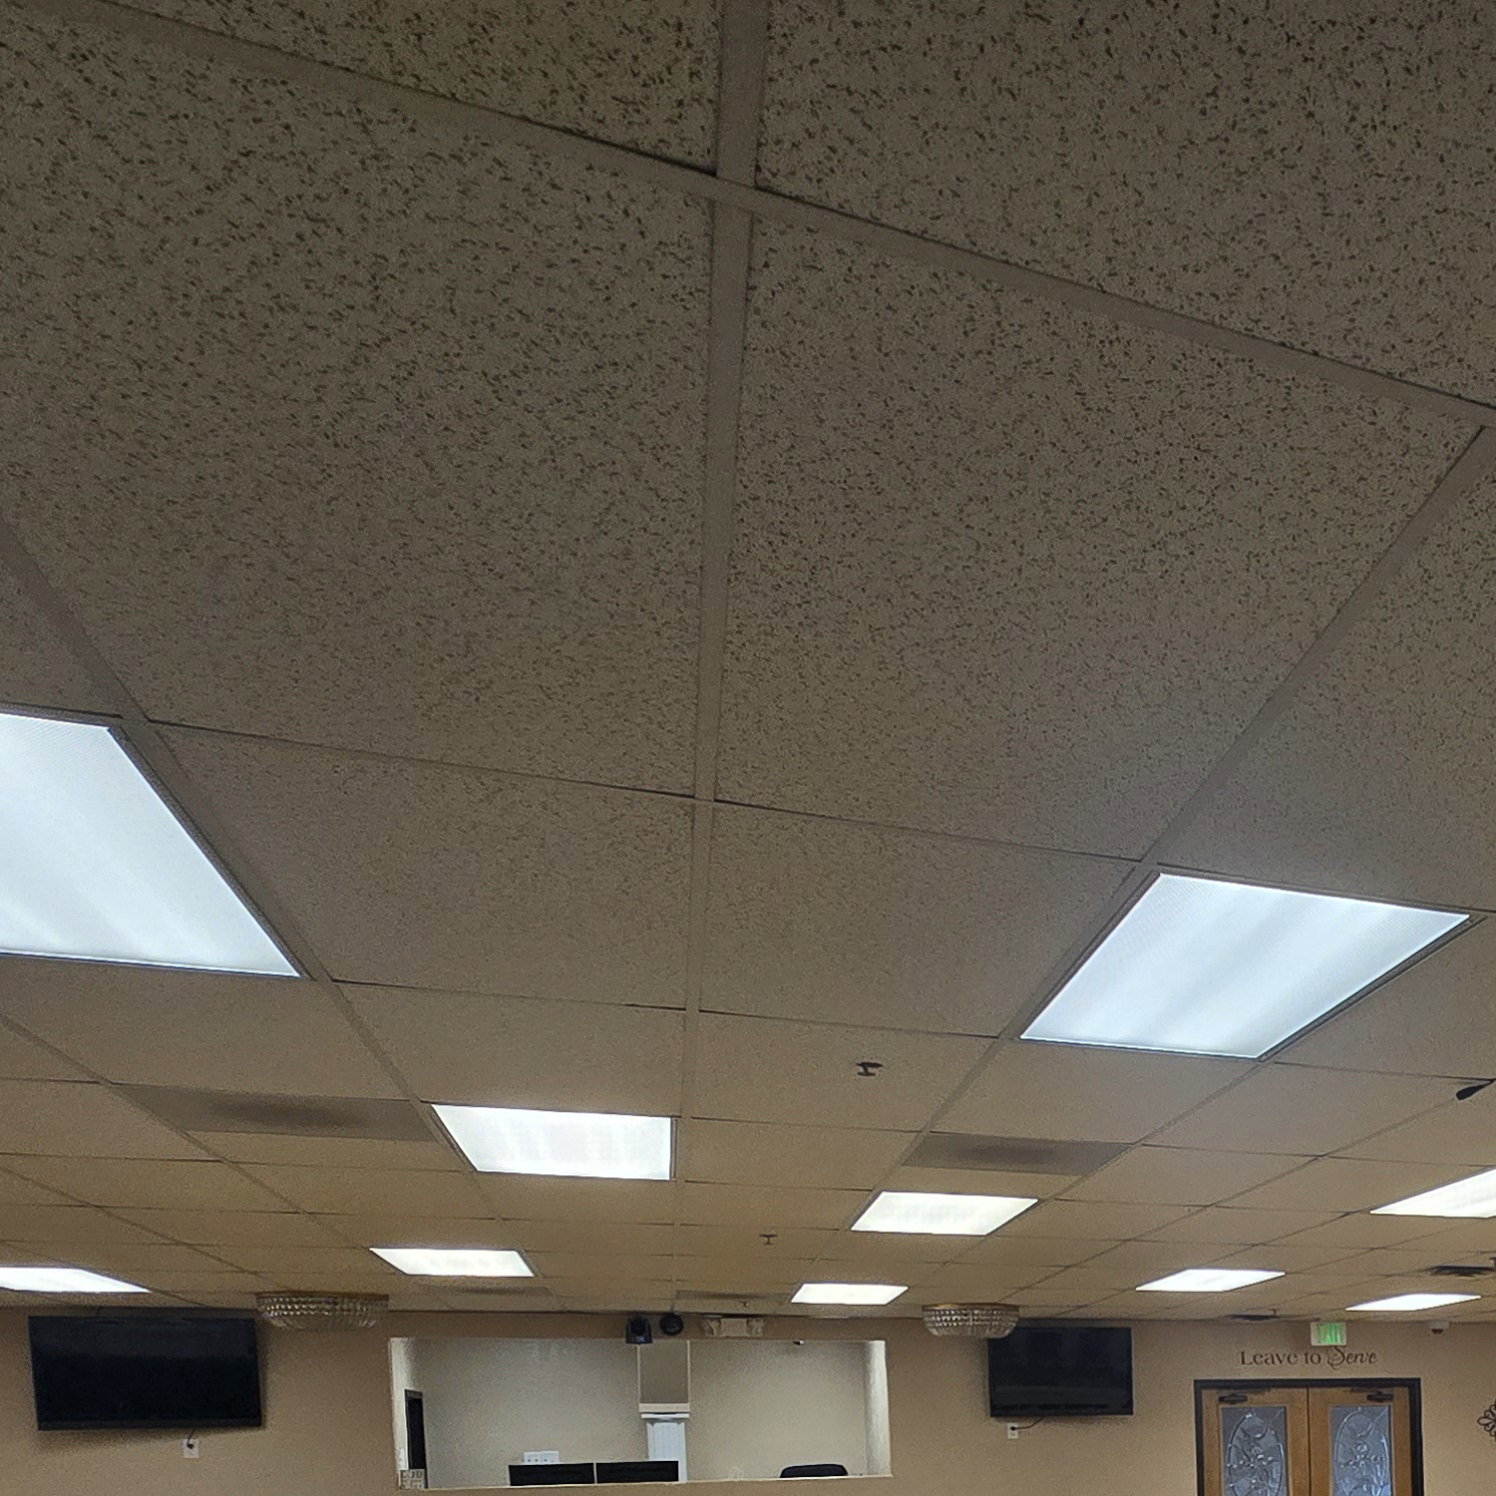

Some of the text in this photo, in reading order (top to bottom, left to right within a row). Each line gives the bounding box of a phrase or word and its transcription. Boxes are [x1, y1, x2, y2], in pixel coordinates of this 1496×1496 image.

[1240, 1346, 1377, 1370] Leave to Serve
